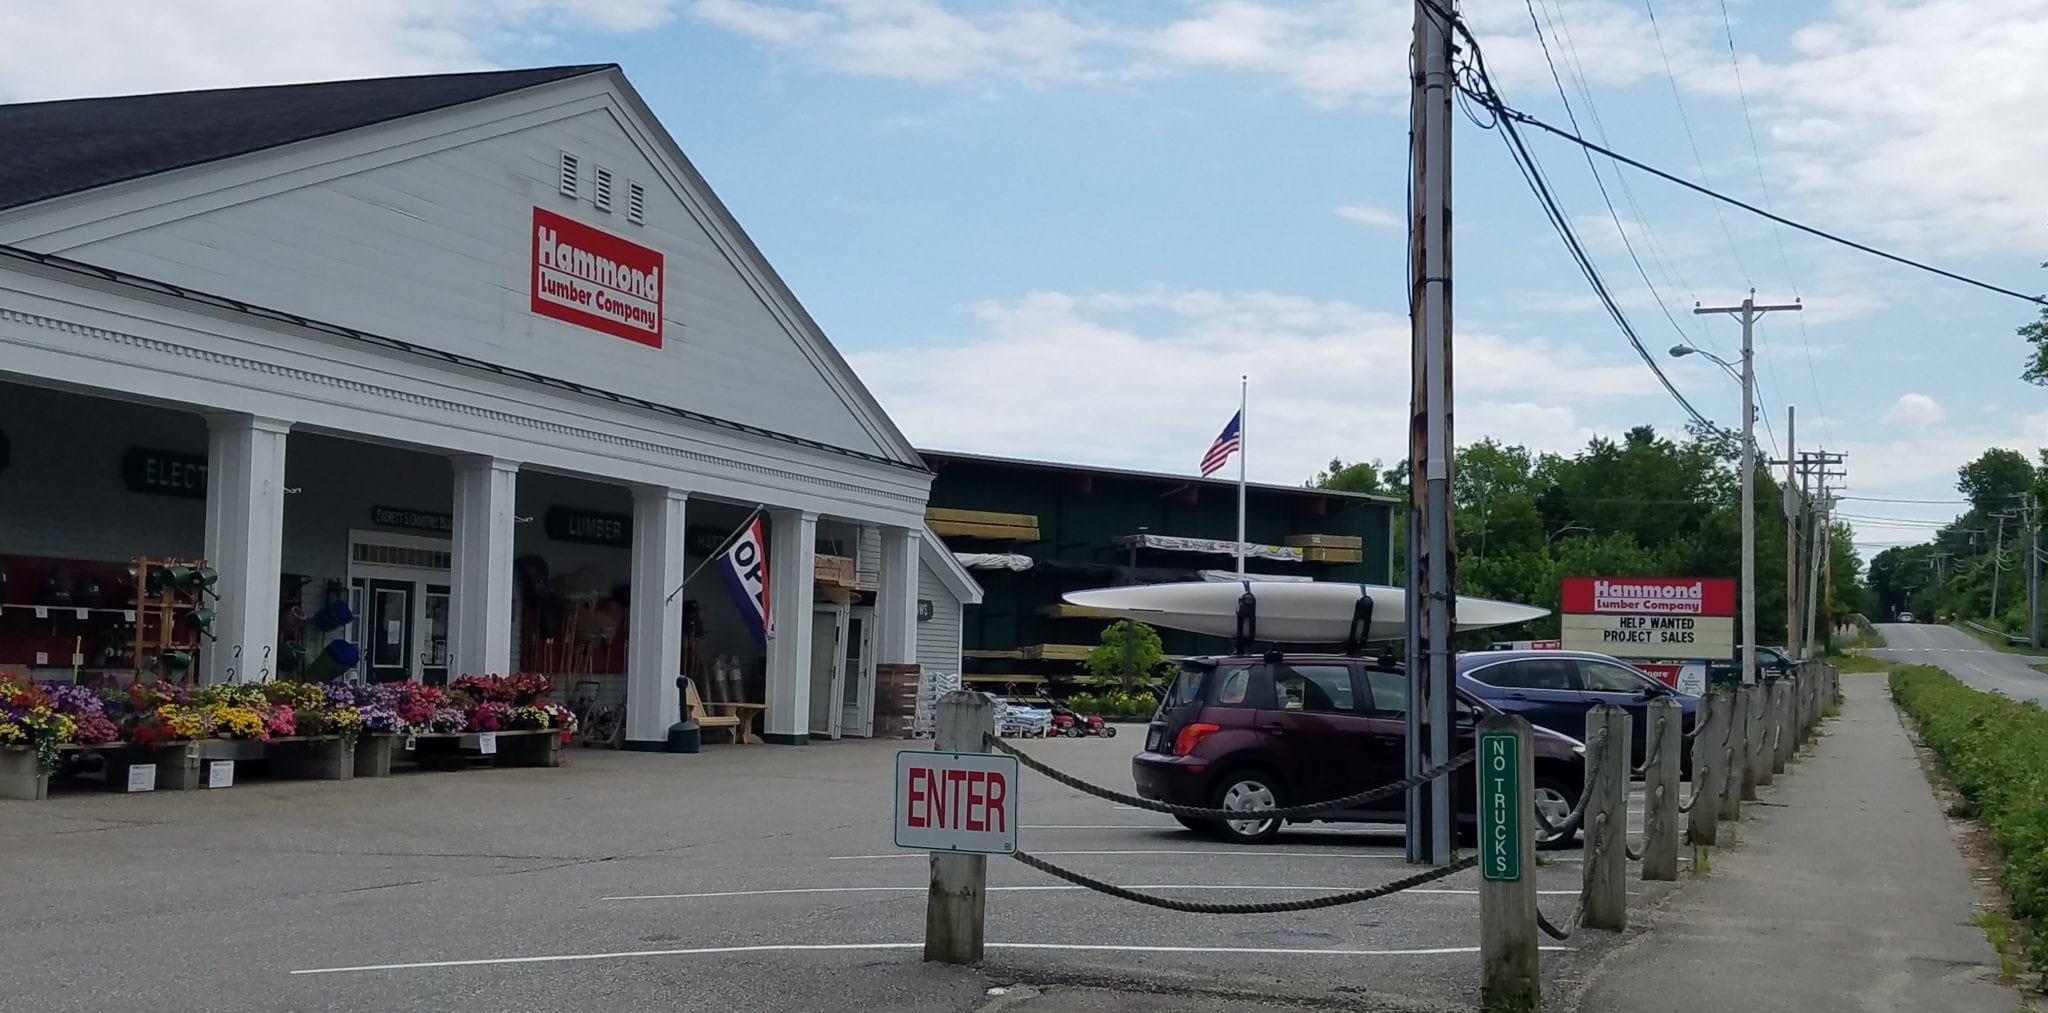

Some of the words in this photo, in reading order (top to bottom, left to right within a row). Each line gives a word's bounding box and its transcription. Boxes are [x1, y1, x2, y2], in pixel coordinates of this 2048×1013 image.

[538, 226, 659, 299] Hammond
[541, 271, 592, 306] Lumber
[595, 290, 656, 330] Company
[568, 512, 624, 541] LUMBER
[1594, 580, 1702, 598] Hammond
[1597, 598, 1640, 609] Lumber
[1643, 599, 1700, 613] Company
[1603, 630, 1652, 643] PROJECT
[1660, 631, 1695, 643] SALES
[1620, 616, 1646, 629] HELP
[1650, 617, 1695, 629] WANTED
[1493, 740, 1506, 771] NO
[908, 767, 1006, 833] ENTER
[1494, 778, 1507, 872] TRUCKS
